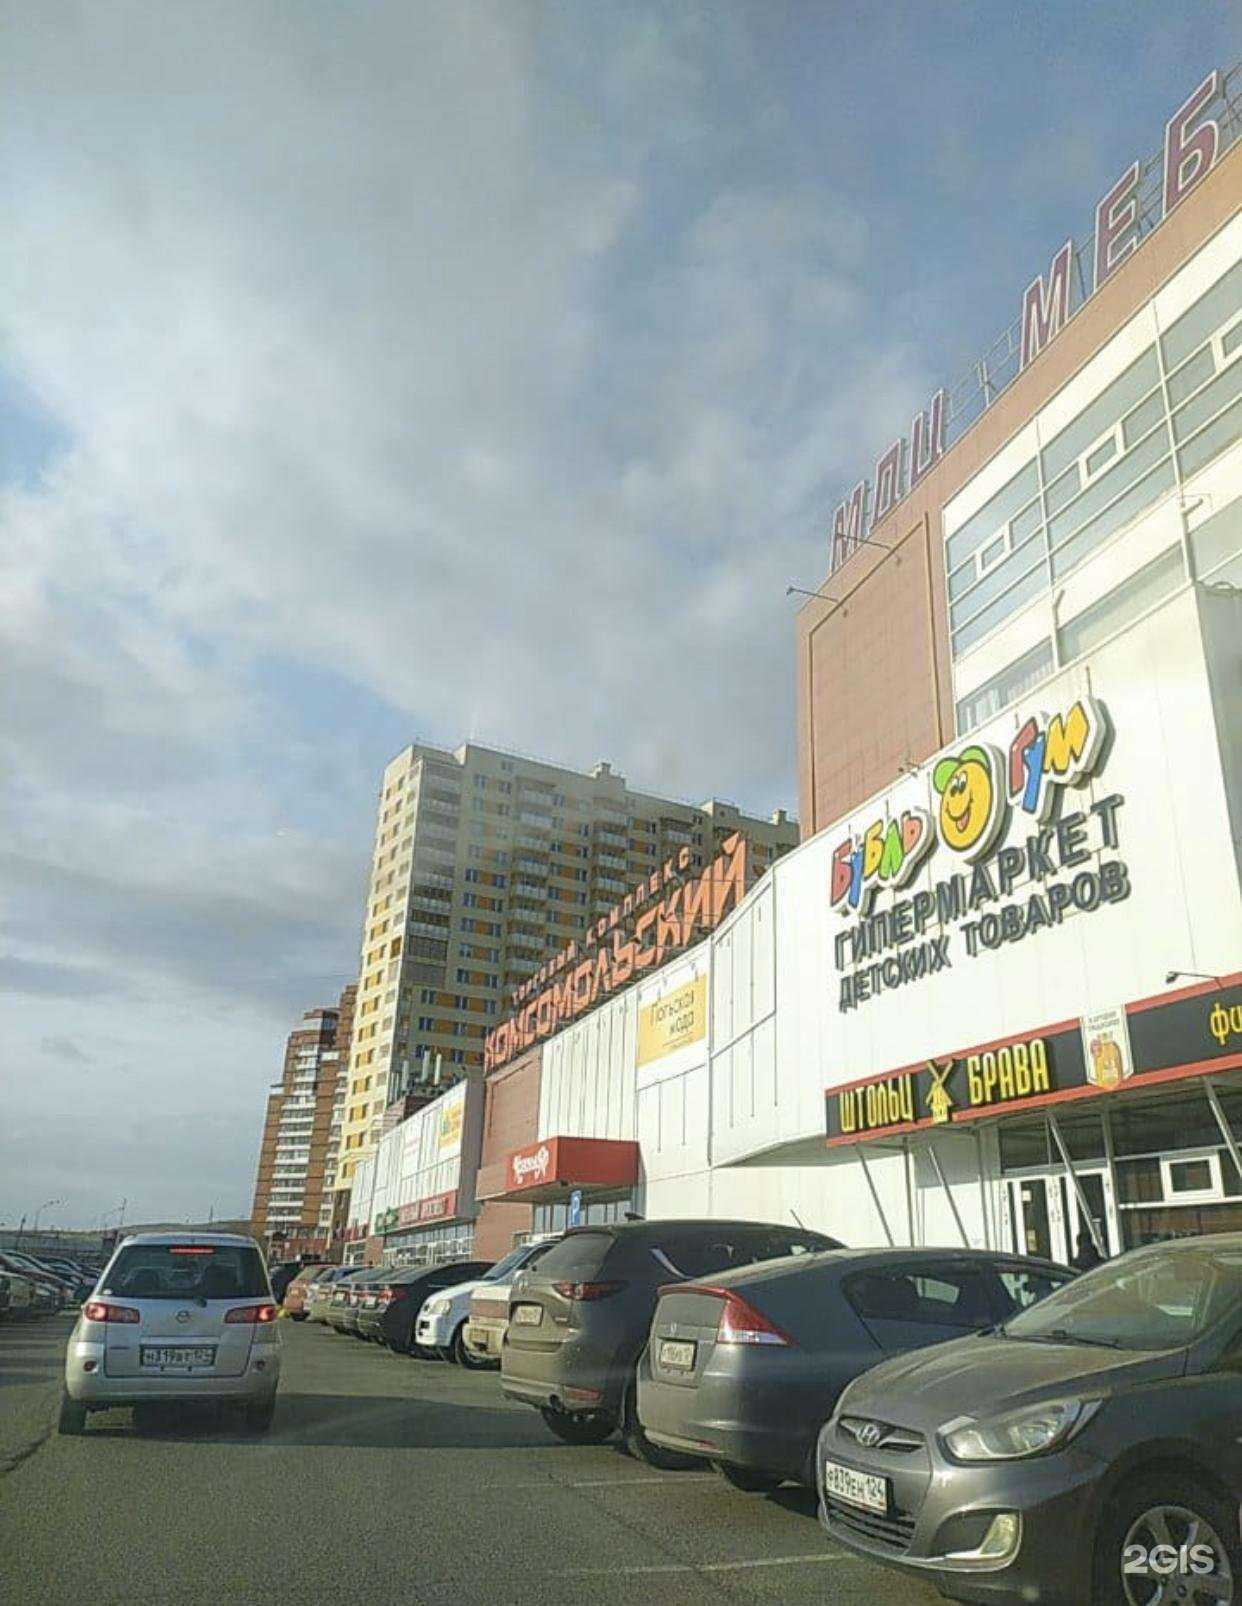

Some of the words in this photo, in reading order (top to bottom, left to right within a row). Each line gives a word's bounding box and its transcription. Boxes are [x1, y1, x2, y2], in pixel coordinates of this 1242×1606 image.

[1008, 701, 1090, 814] ГУМ
[586, 846, 691, 949] КОМПЛЕКС
[834, 794, 1125, 971] ГИПЕРМАРКЕТ
[838, 934, 952, 1014] ДЕТСКИХ
[960, 860, 1132, 957] ТОВАРОВ
[484, 831, 747, 1077] КОМСОМОЛЬСКИЙ
[839, 1072, 916, 1133] ШТОЛЬЦ
[966, 1039, 1050, 1105] БРАВА
